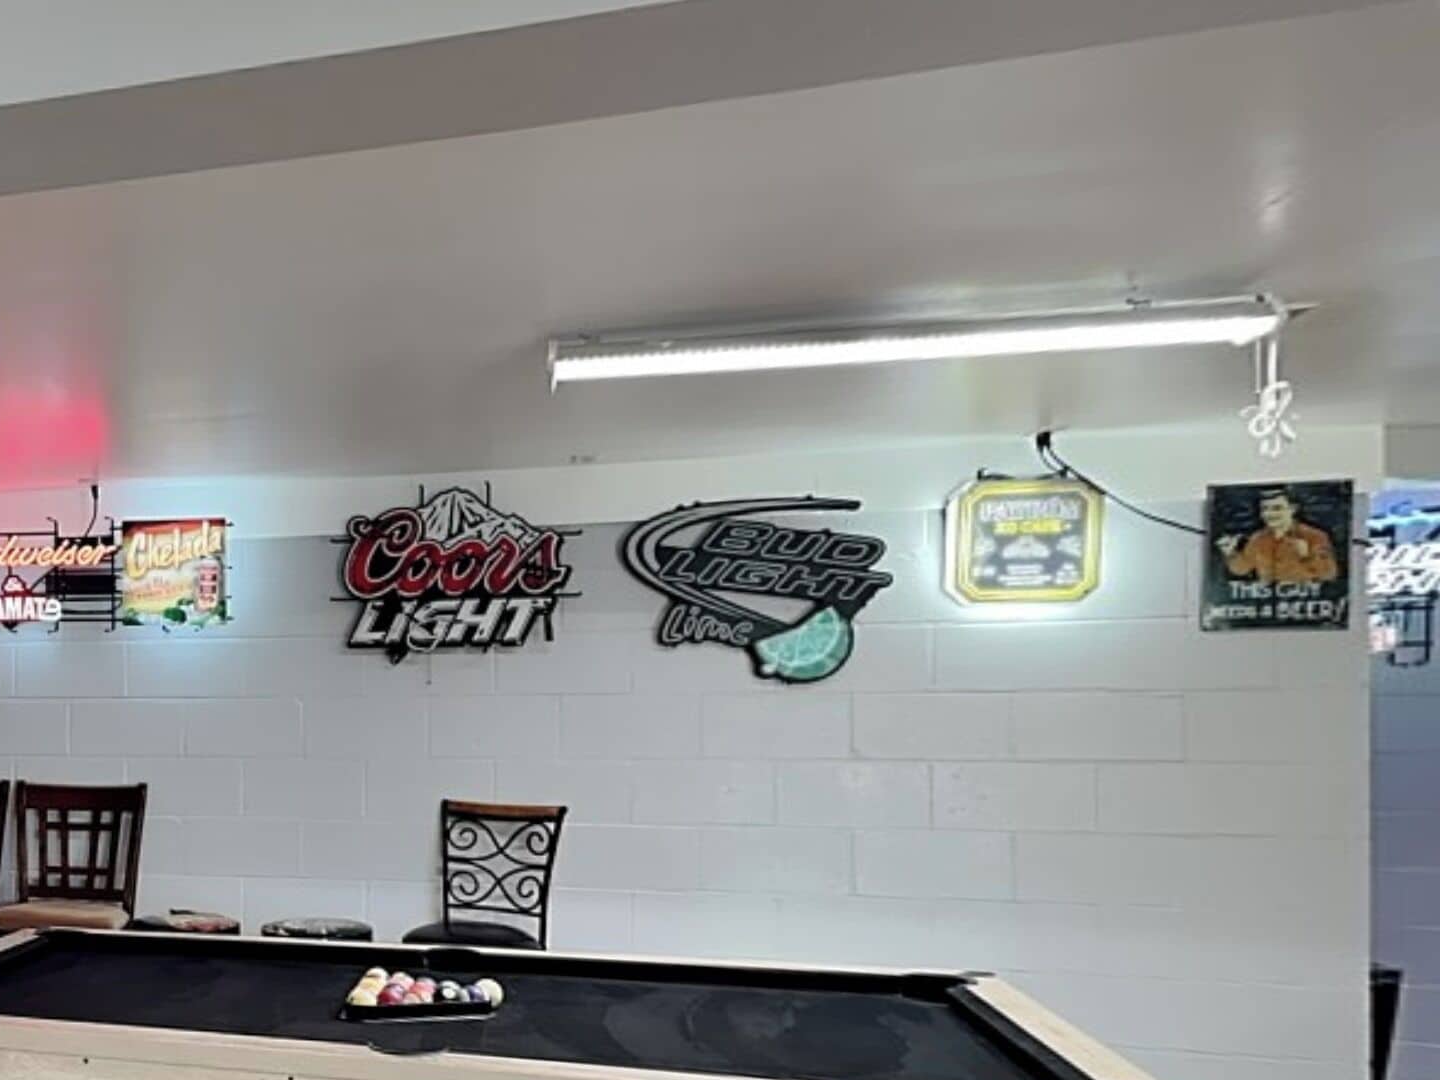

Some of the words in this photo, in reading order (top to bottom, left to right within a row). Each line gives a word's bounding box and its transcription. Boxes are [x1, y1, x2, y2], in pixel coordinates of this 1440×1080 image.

[126, 519, 222, 578] Chelada
[345, 507, 569, 597] Coors
[702, 519, 887, 566] BUD
[659, 550, 894, 600] LIGHT
[1228, 580, 1273, 599] THIS
[1275, 580, 1322, 598] GUY
[349, 598, 553, 650] LIGHT
